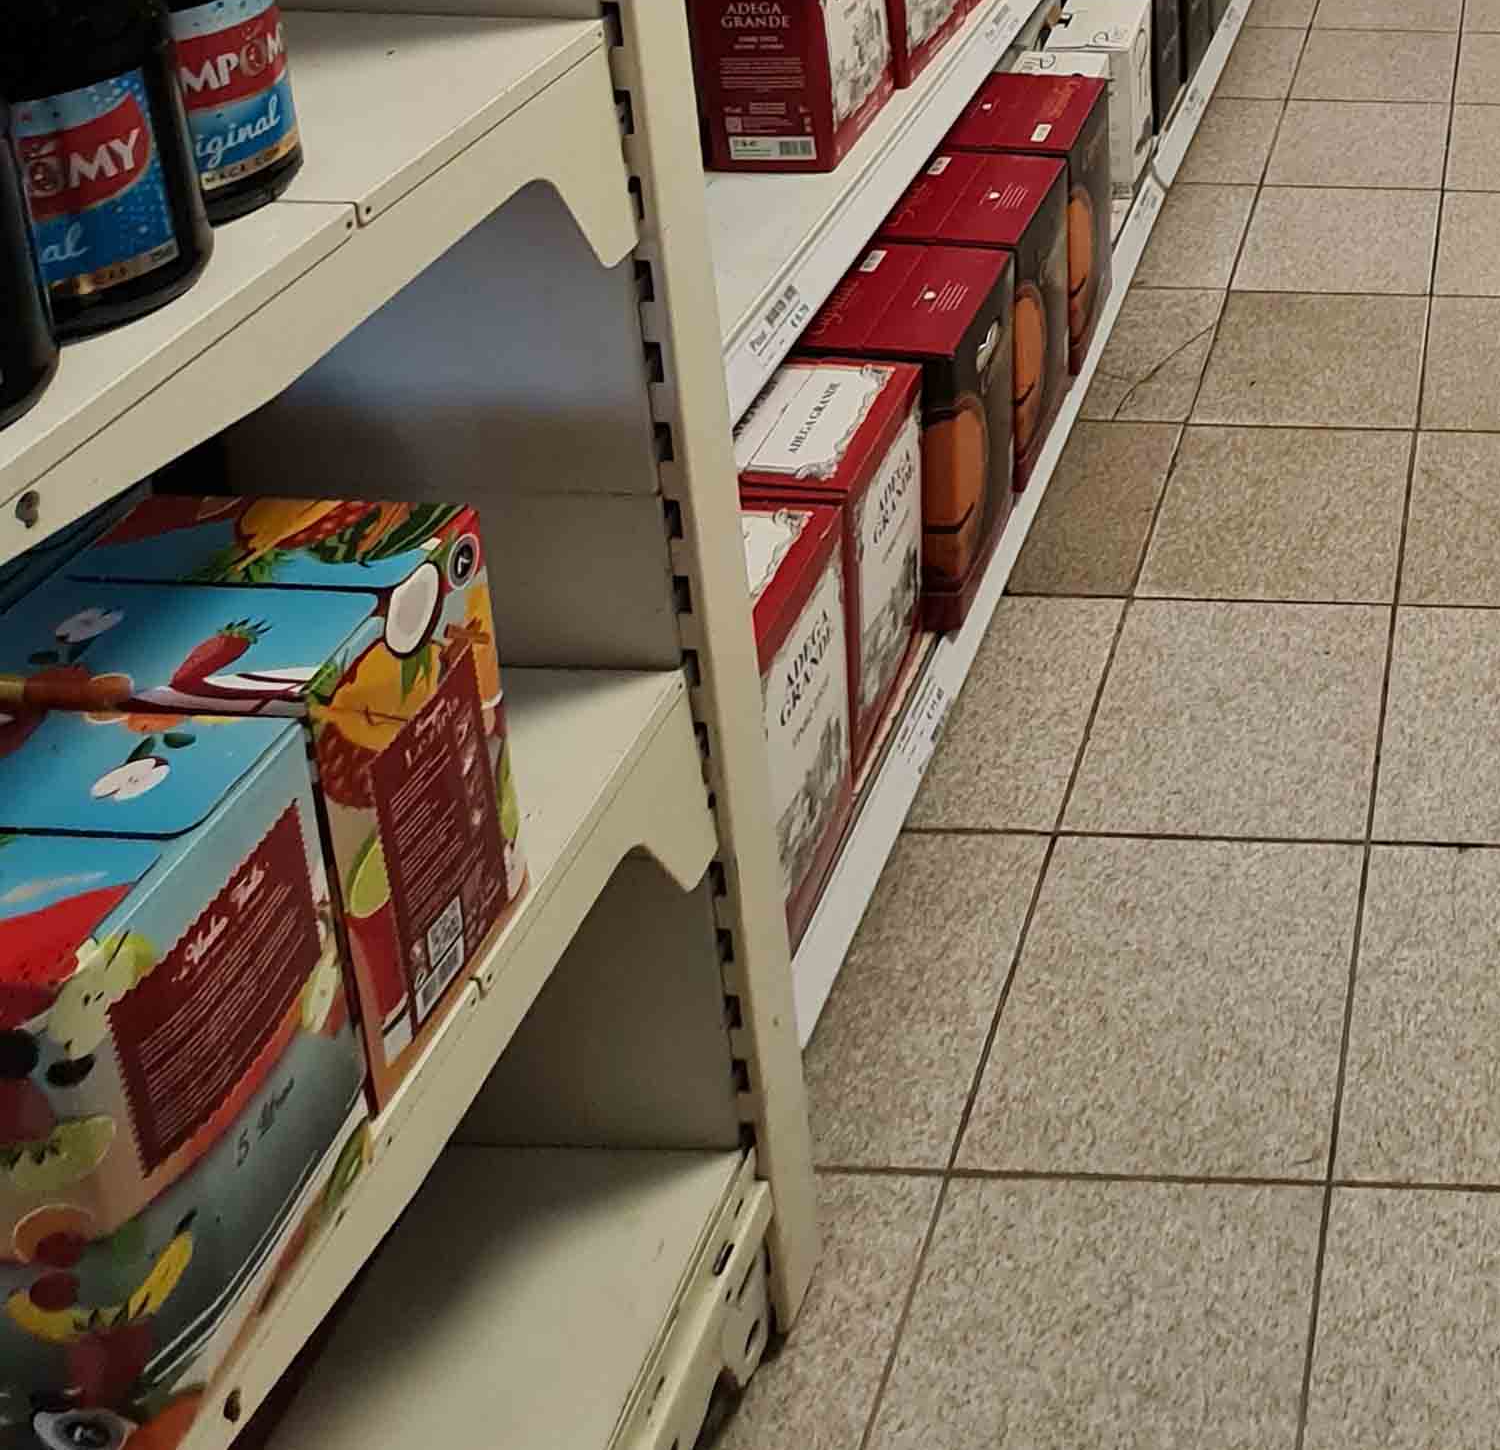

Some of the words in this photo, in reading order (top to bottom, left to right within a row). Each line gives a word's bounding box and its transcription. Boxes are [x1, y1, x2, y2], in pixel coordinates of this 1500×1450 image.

[720, 15, 790, 29] GRANDE
[726, 2, 783, 16] ADEGA
[878, 447, 911, 513] ADEGA
[779, 626, 831, 727] GRANDE
[786, 609, 829, 686] ADEGA
